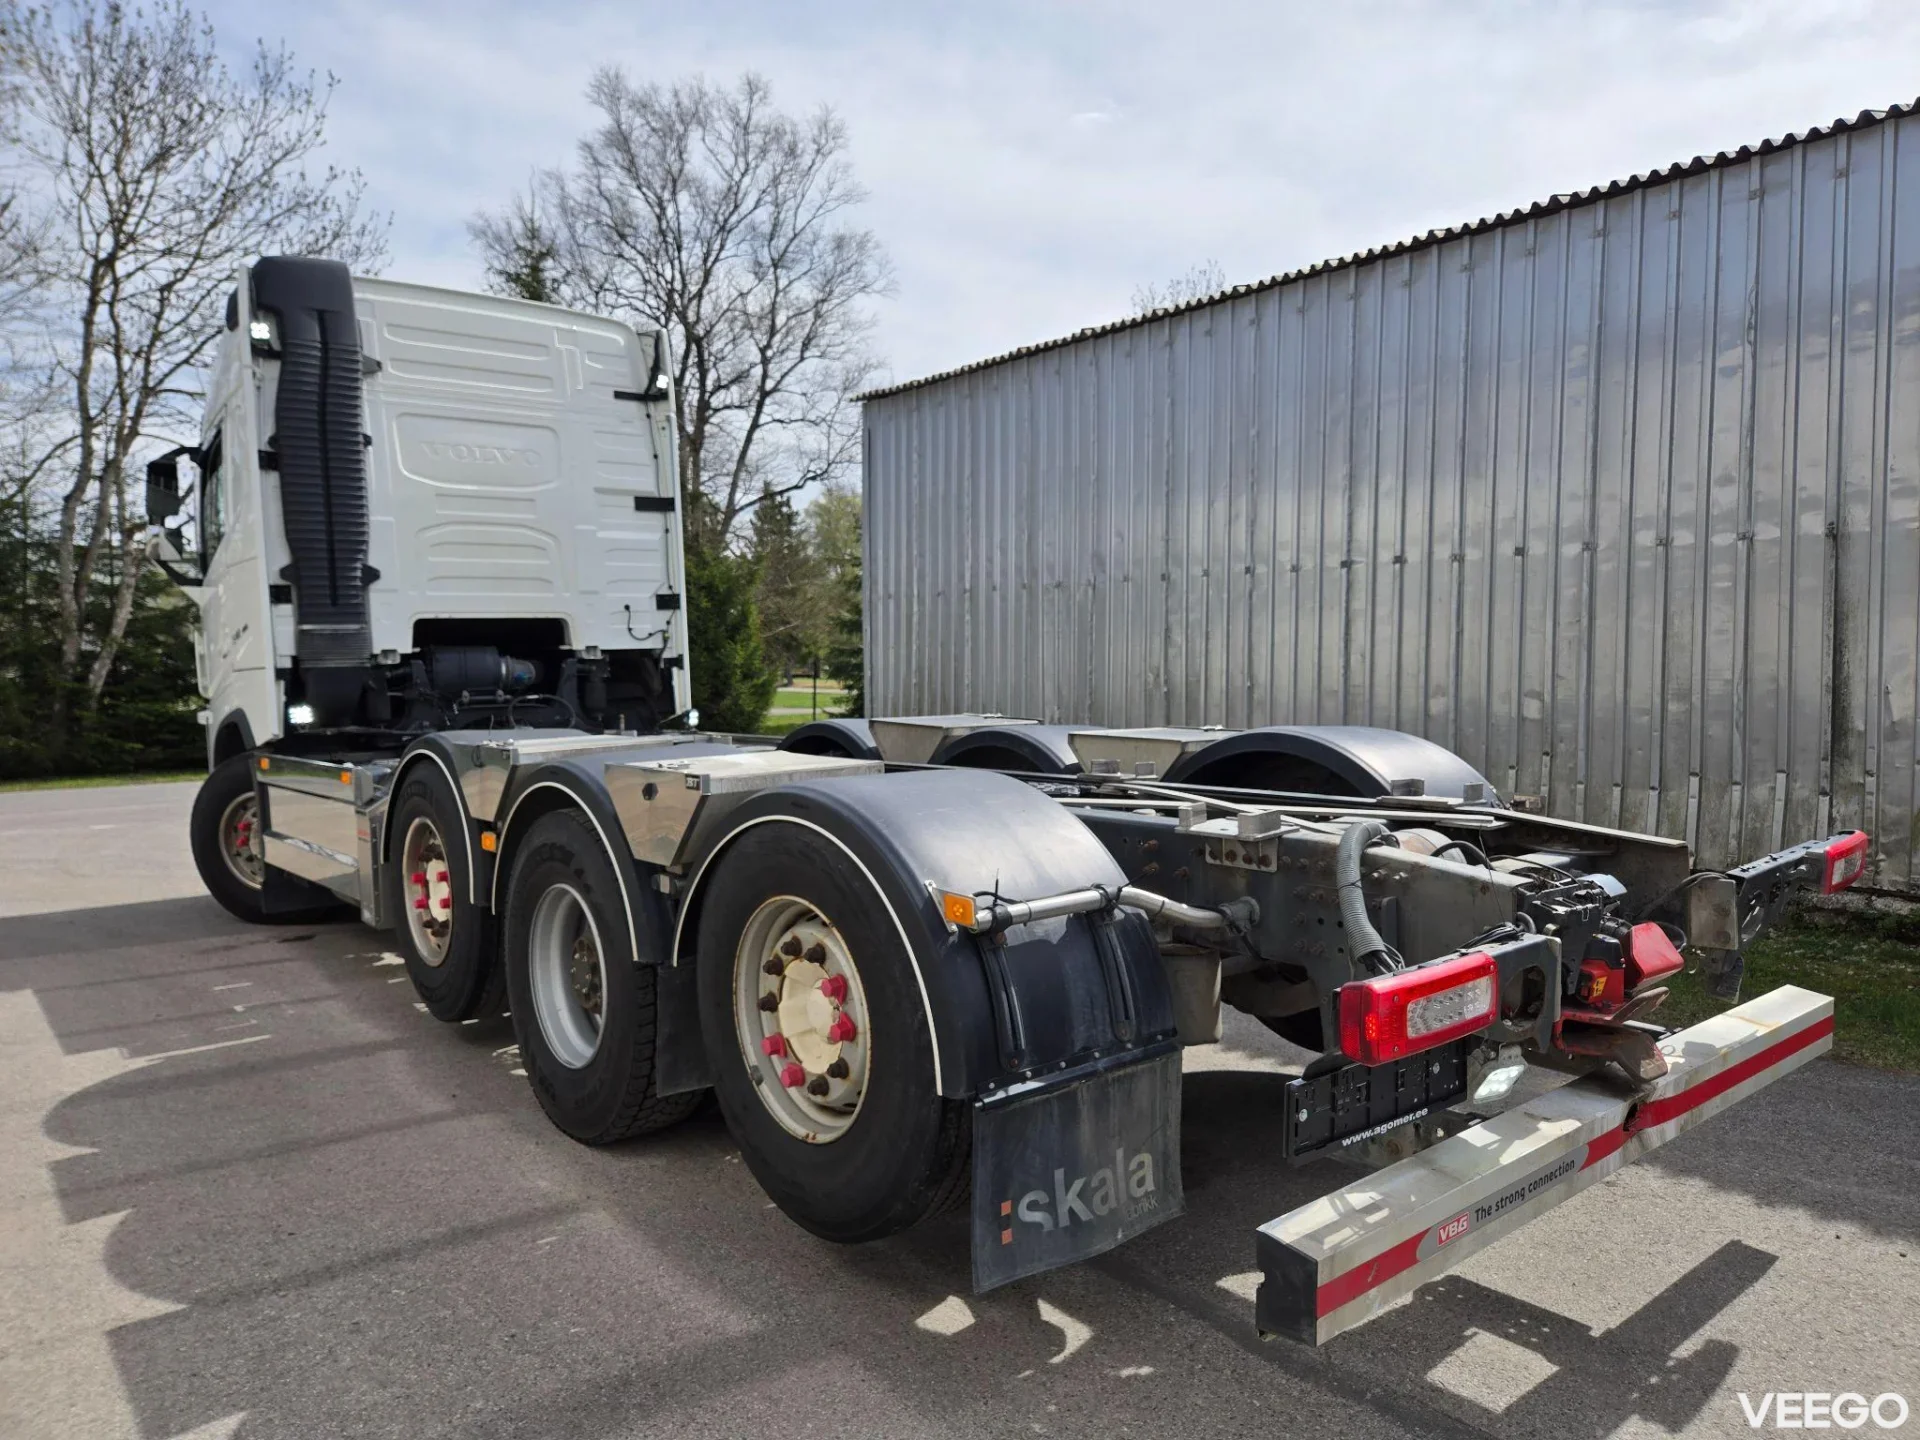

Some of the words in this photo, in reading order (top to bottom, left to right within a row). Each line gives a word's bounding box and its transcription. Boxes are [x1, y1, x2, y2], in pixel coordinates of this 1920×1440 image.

[419, 441, 543, 468] VOLVO
[1342, 1107, 1429, 1147] www.agomer.ee
[1017, 1147, 1156, 1232] skala
[1475, 1206, 1493, 1223] The
[1495, 1186, 1526, 1213] strong
[1528, 1158, 1575, 1194] connection
[1438, 1215, 1468, 1242] VBG
